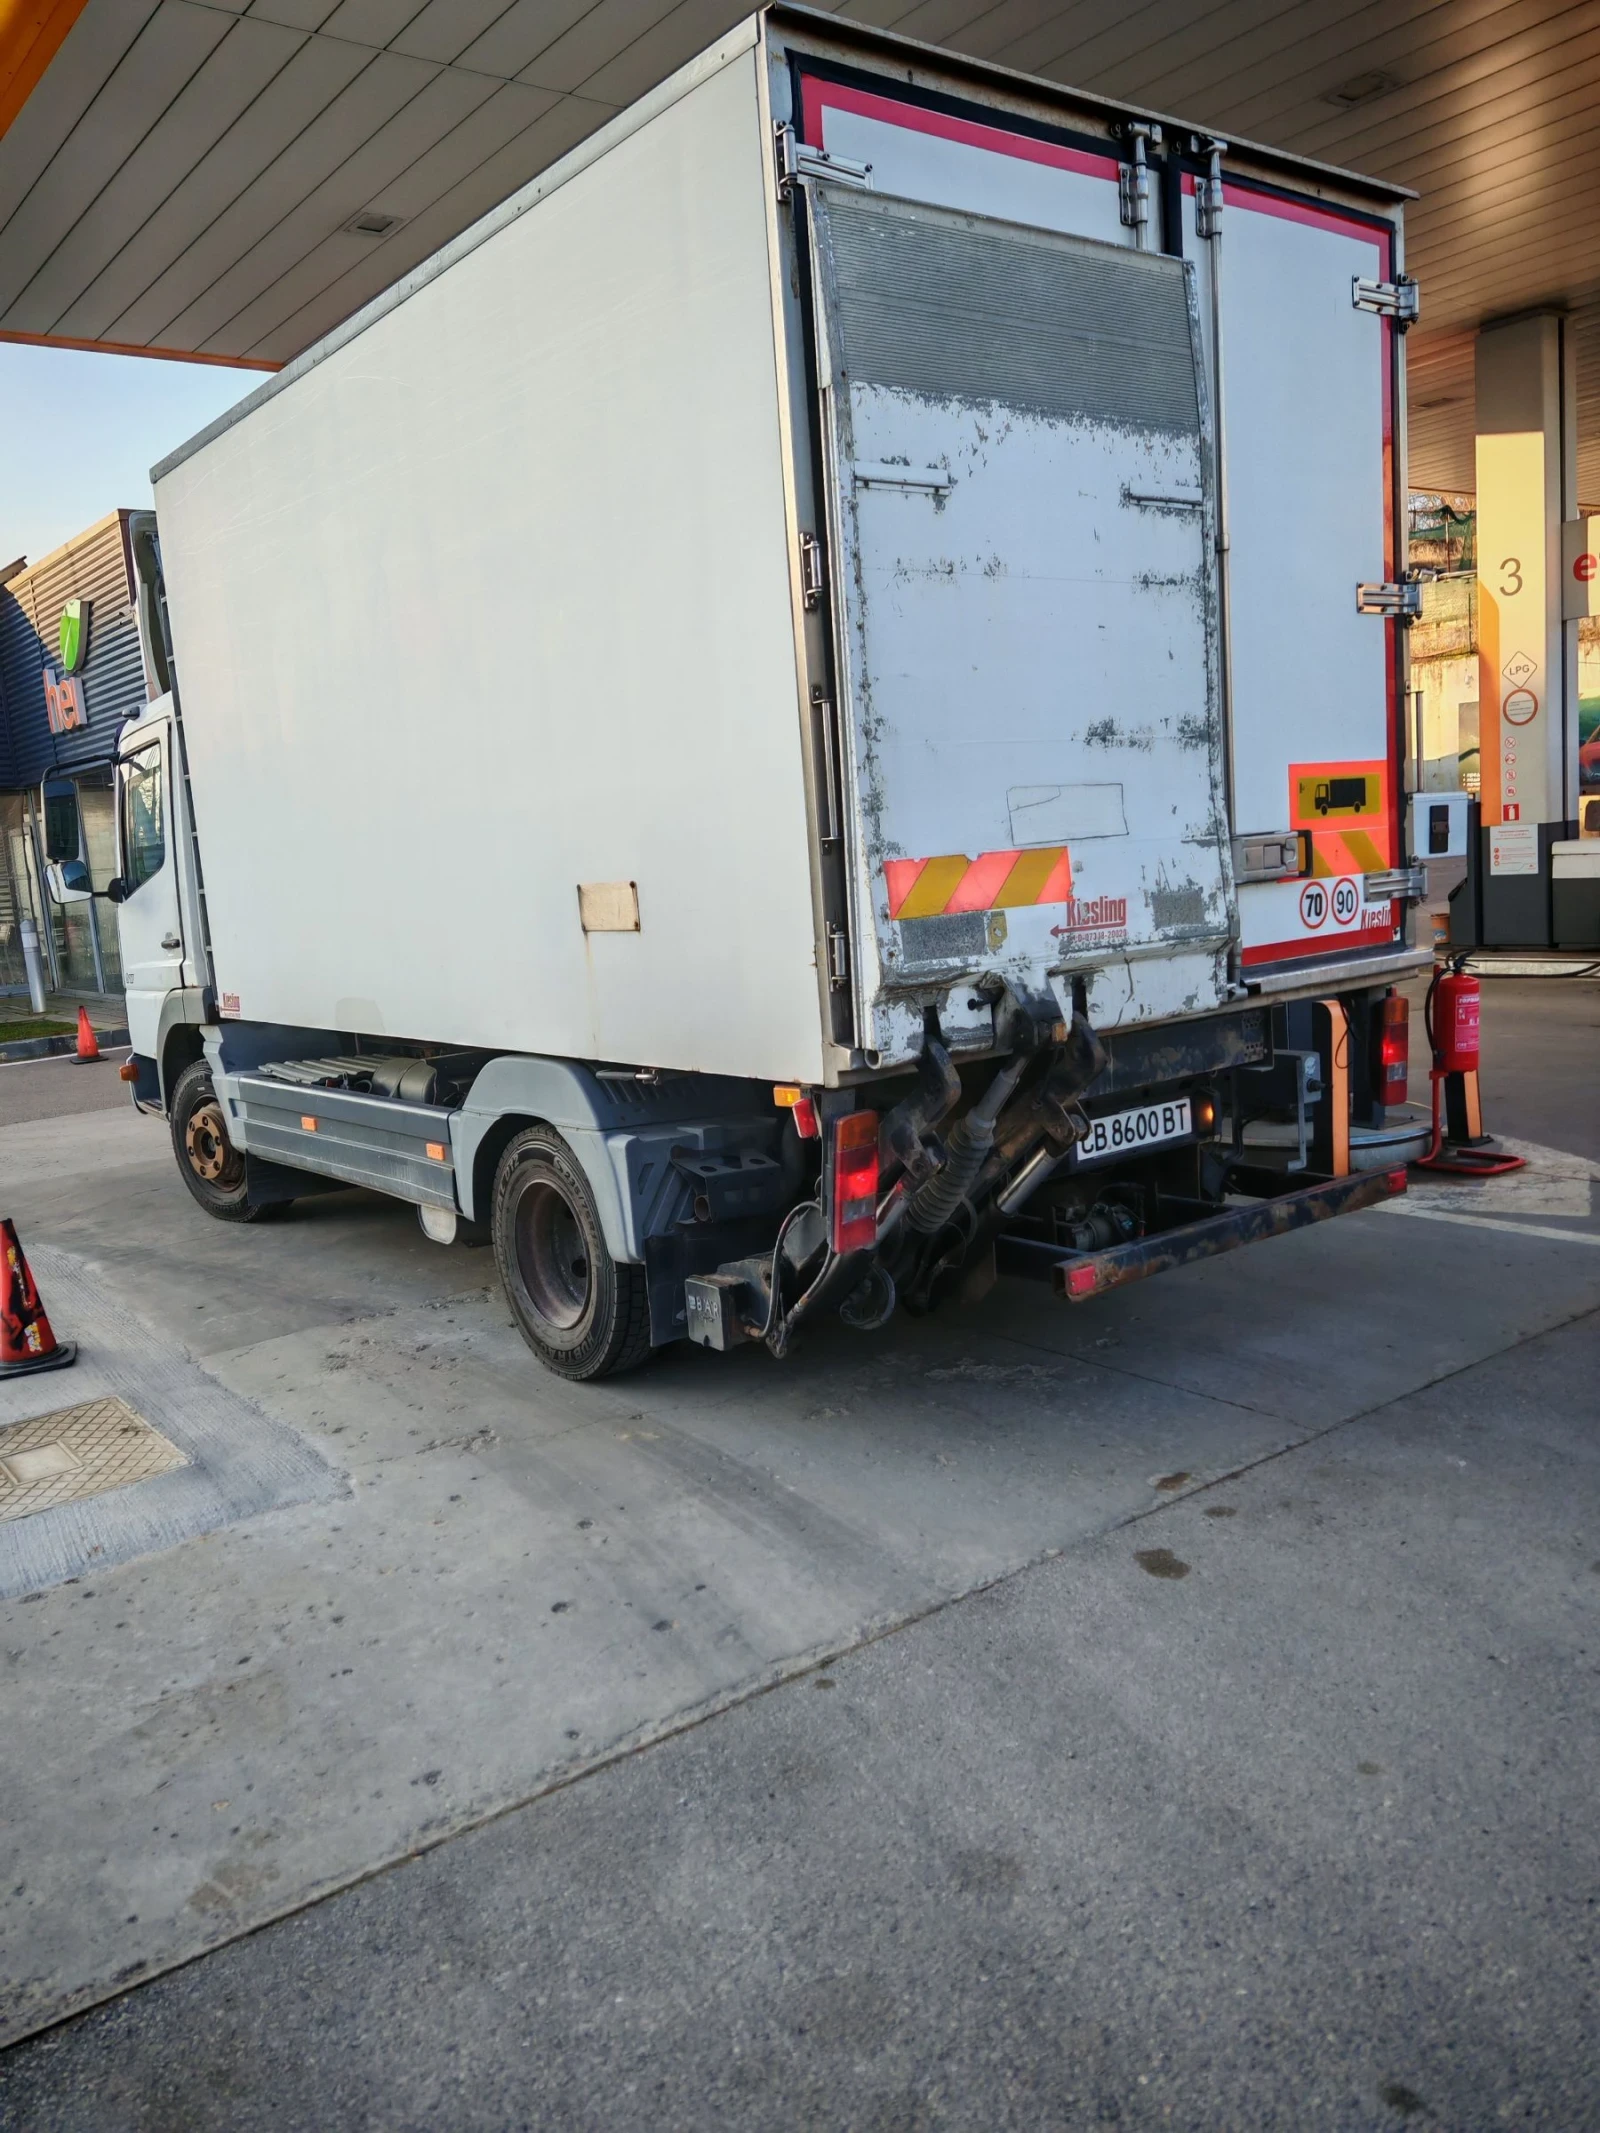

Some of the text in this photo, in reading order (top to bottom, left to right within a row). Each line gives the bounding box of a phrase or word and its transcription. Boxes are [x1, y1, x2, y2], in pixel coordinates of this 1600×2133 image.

[1499, 557, 1523, 597] 3
[1509, 664, 1530, 676] LPG
[1305, 892, 1323, 918] 70
[1336, 889, 1354, 915] 90
[1112, 1109, 1158, 1146] 8600
[1163, 1103, 1187, 1134] BT
